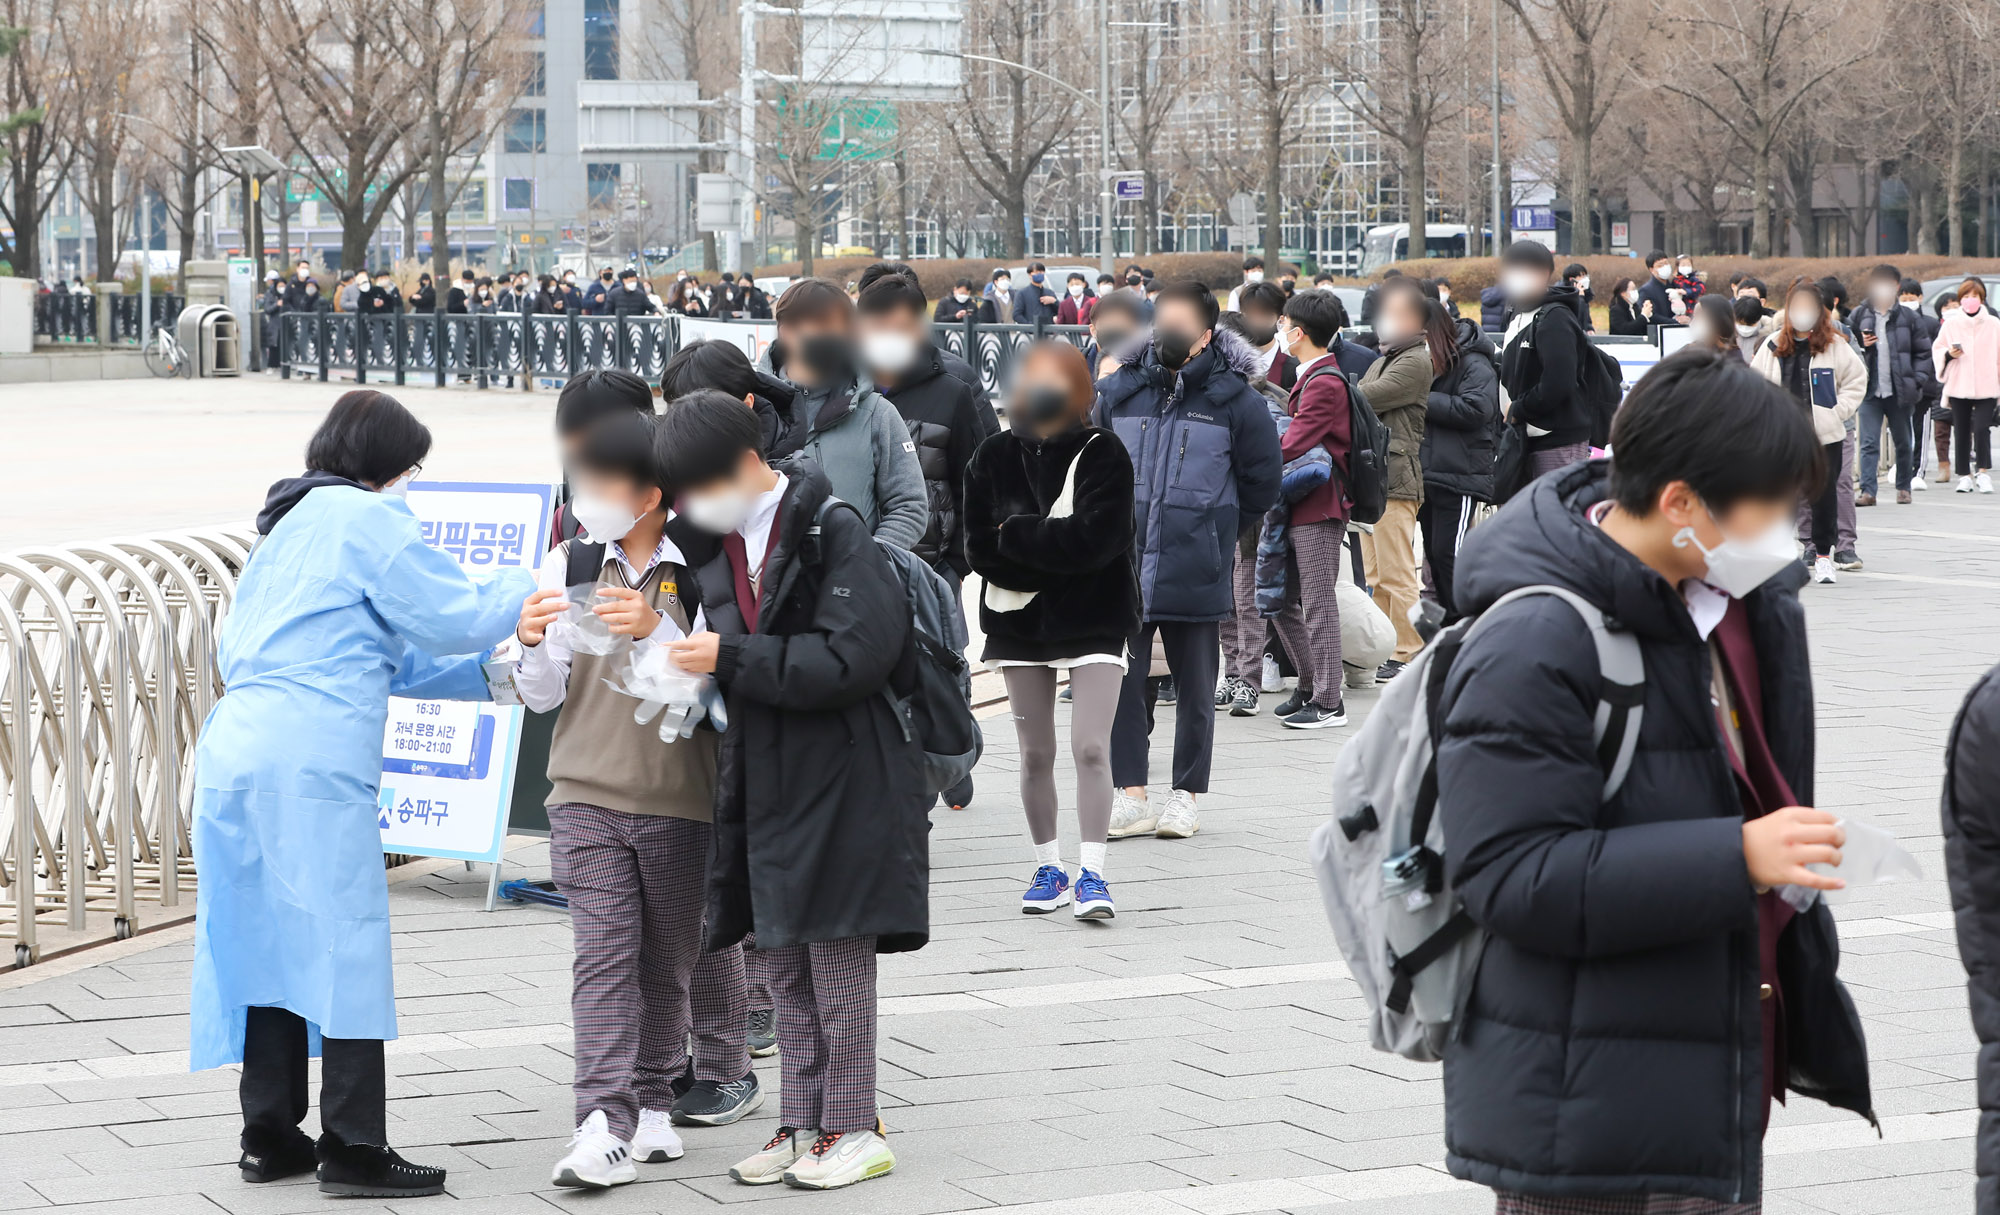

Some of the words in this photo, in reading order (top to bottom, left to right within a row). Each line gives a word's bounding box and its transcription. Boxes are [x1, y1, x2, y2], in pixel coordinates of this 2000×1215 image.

[1192, 412, 1214, 421] Columbia
[832, 586, 851, 598] K2
[416, 702, 441, 716] 16:30
[395, 721, 414, 735] 저녁
[415, 723, 435, 737] 운영
[436, 725, 456, 739] 시간
[394, 738, 452, 754] 18:00~21:00
[397, 797, 449, 827] 송파구
